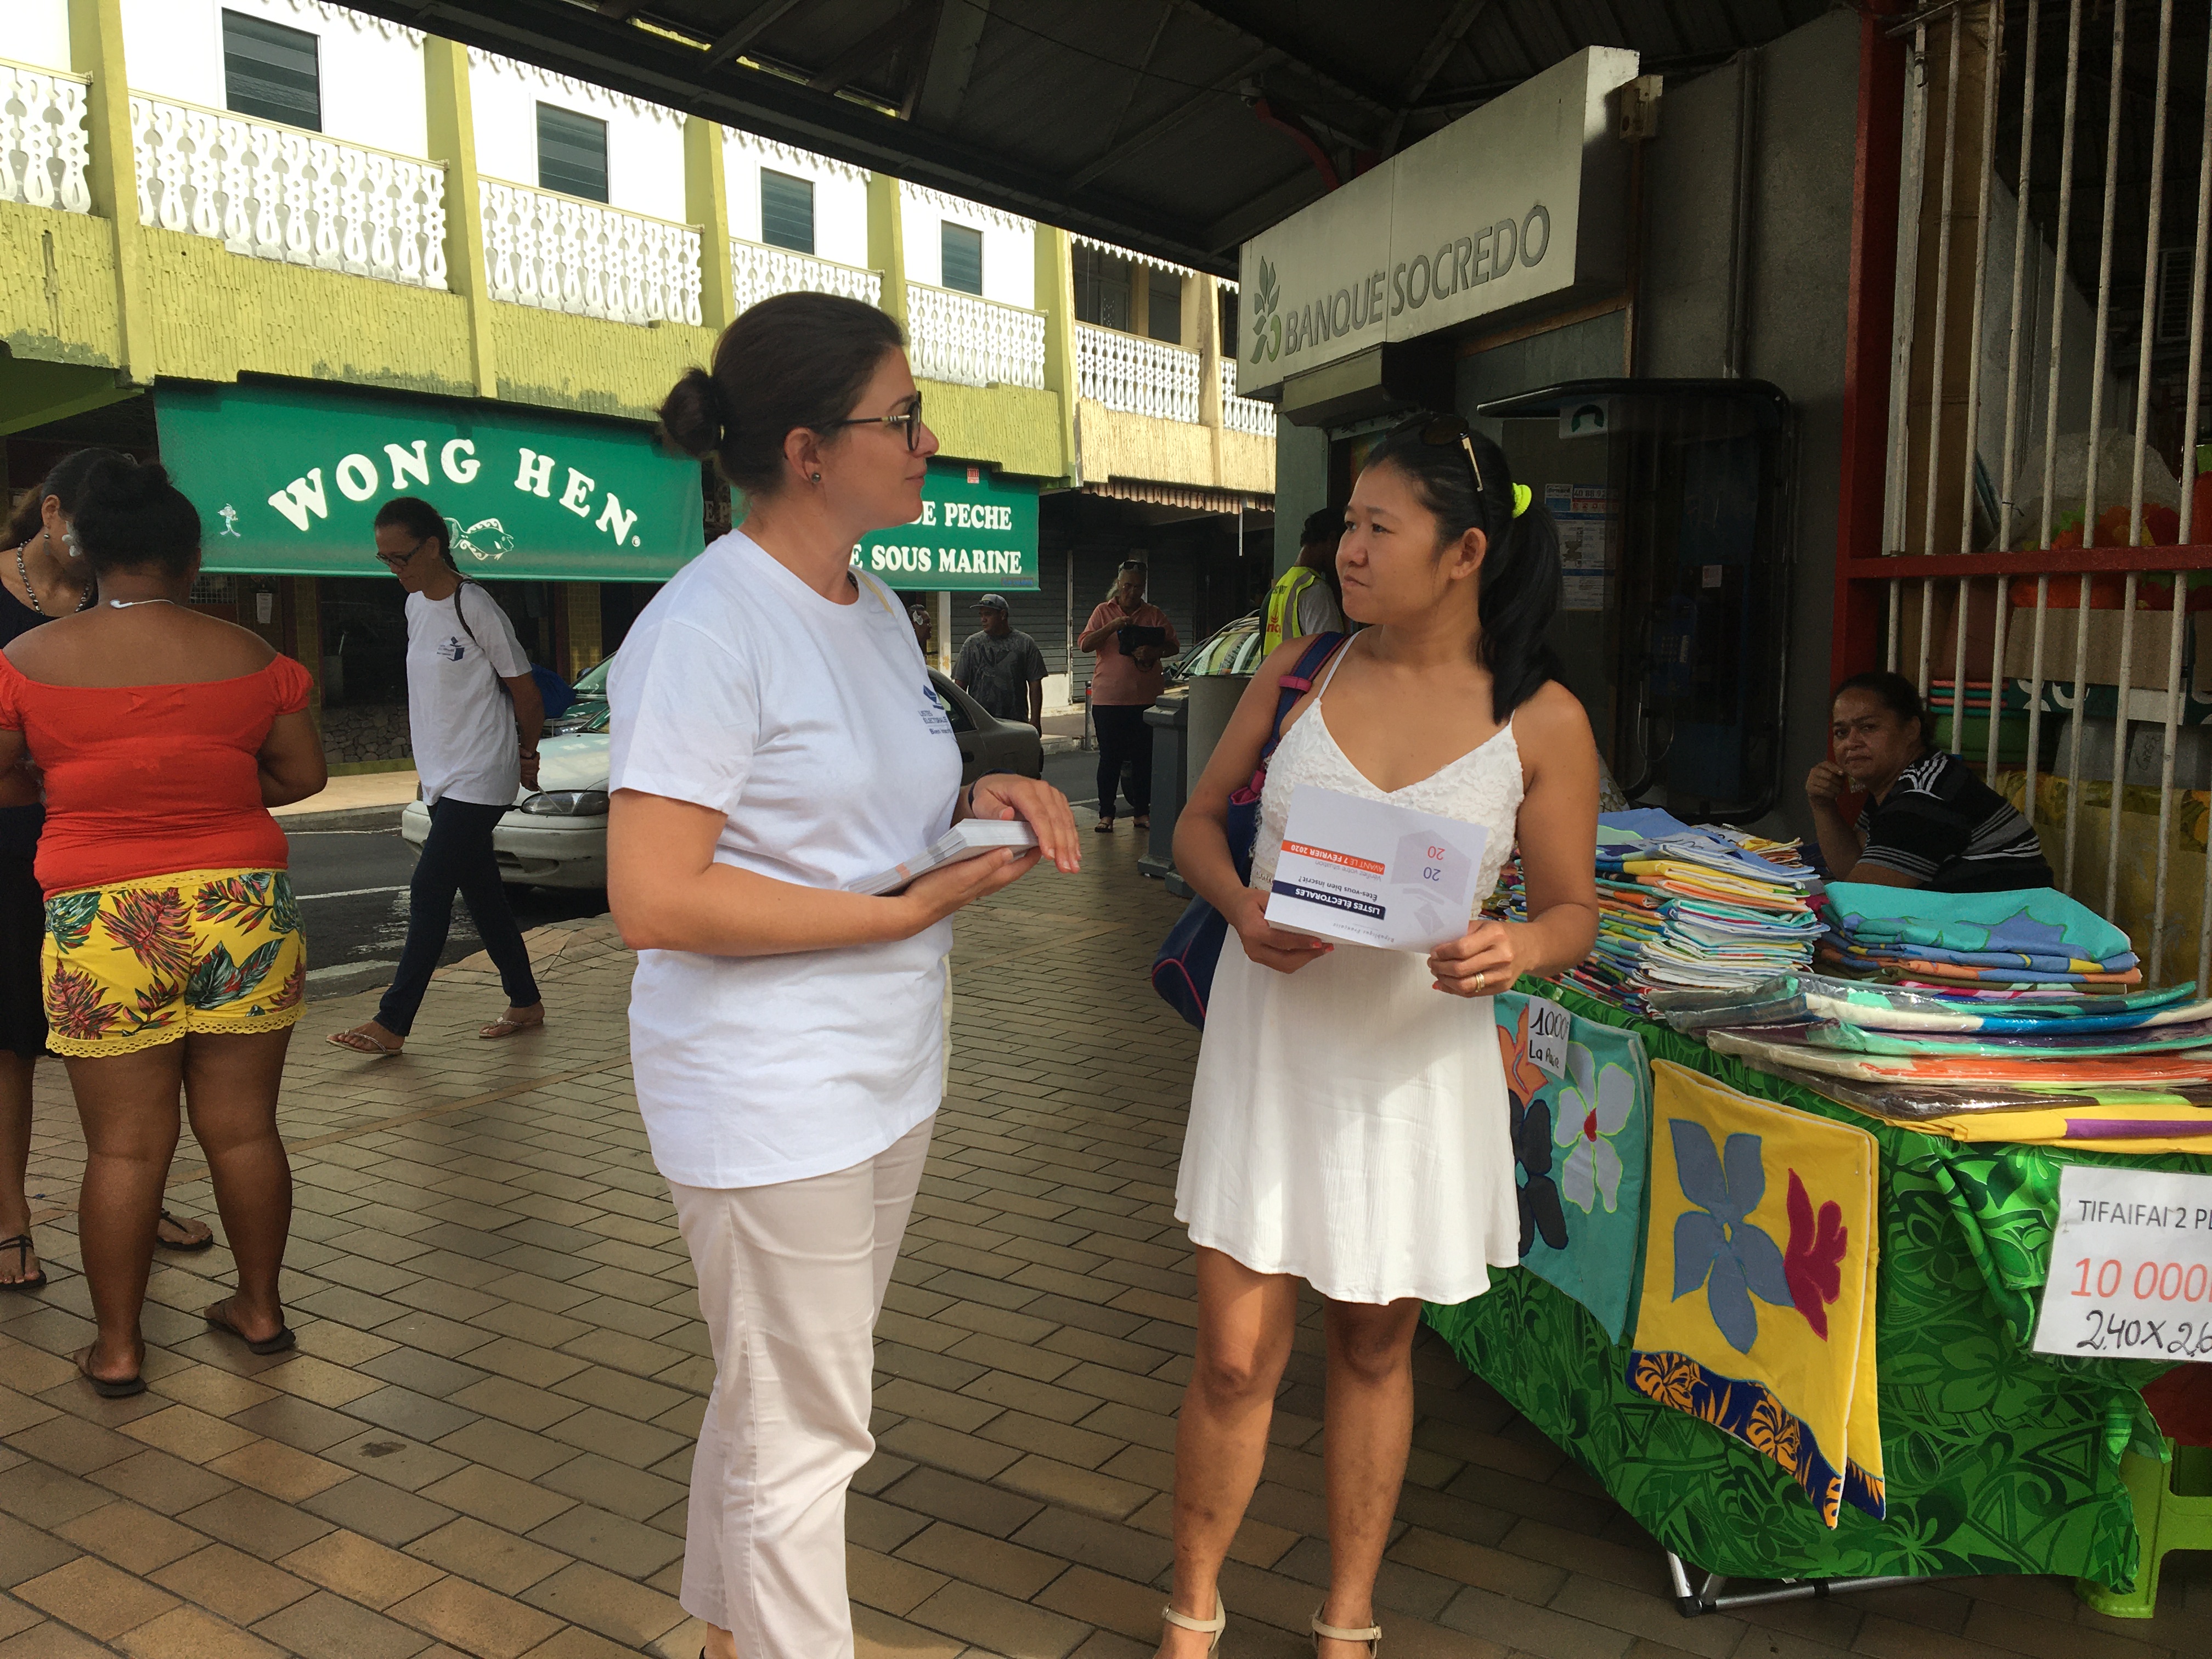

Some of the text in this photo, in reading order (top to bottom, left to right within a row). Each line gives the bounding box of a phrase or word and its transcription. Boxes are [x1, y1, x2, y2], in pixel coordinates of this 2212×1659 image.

[268, 438, 638, 546] WONG HEN
[944, 502, 1012, 531] PECHE
[871, 545, 932, 572] SOUS
[938, 548, 1023, 574] MARINE
[1290, 844, 1308, 854] 2020
[1310, 848, 1342, 861] FÉVRIER
[1427, 845, 1445, 860] 20
[1315, 860, 1340, 870] situation
[1359, 861, 1384, 872] AVANT
[1358, 870, 1381, 882] Vérifiez
[1423, 866, 1441, 881] 20
[1327, 882, 1342, 891] bien
[1344, 887, 1378, 901] Êtes-vous
[1295, 888, 1380, 915] LISTES ÉLECTORALES
[1529, 1040, 1543, 1061] La
[2078, 1200, 2168, 1227] TIFAIFAI
[2175, 1207, 2187, 1228] 2
[2070, 1257, 2212, 1302] 10 000
